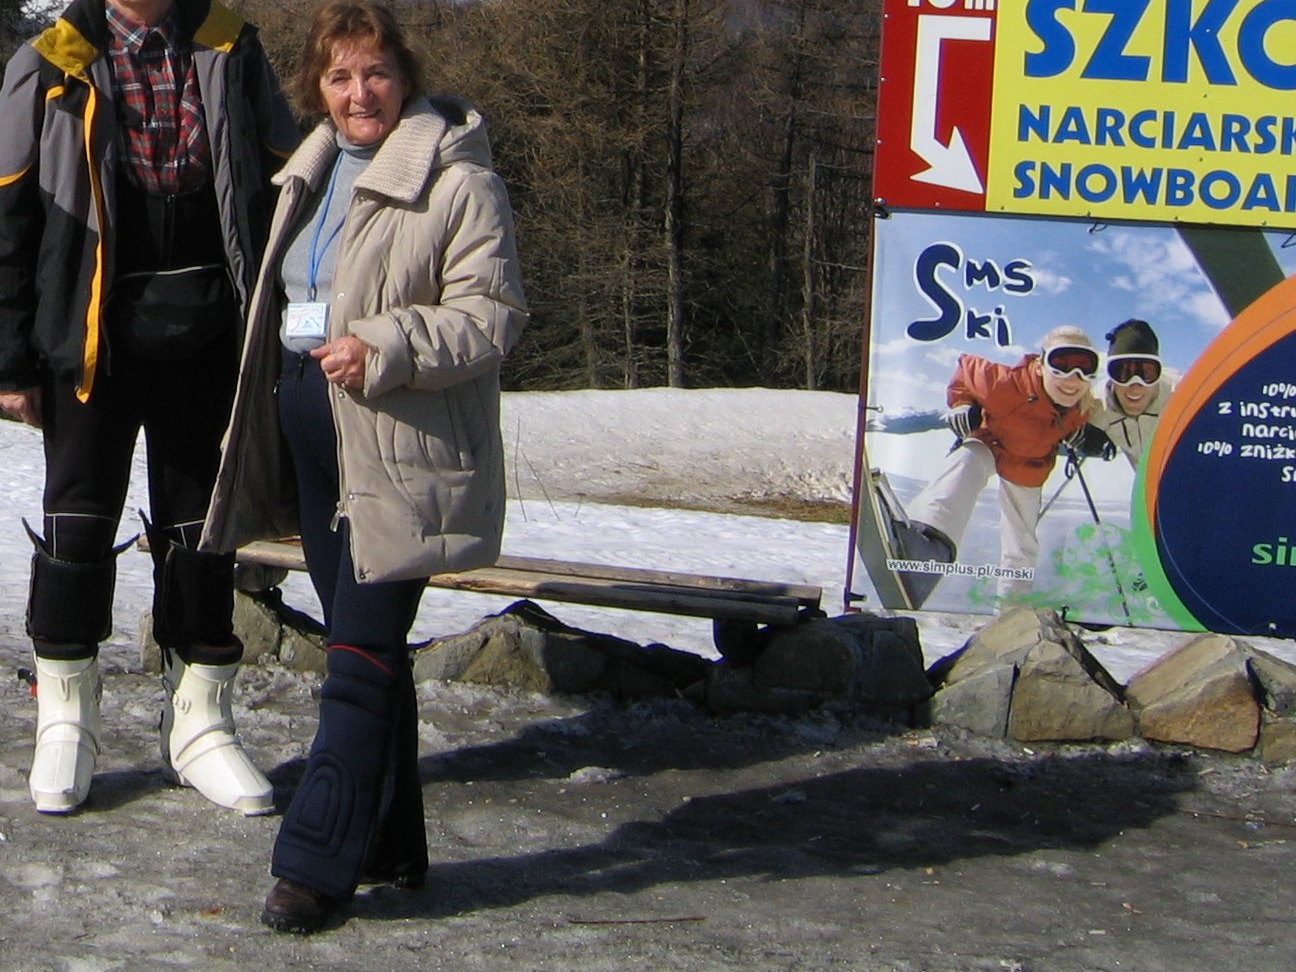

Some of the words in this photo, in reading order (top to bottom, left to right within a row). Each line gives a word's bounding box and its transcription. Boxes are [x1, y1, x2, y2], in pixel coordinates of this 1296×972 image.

[1242, 423, 1296, 441] narci
[1197, 440, 1233, 457] 10%
[1251, 536, 1296, 566] si
